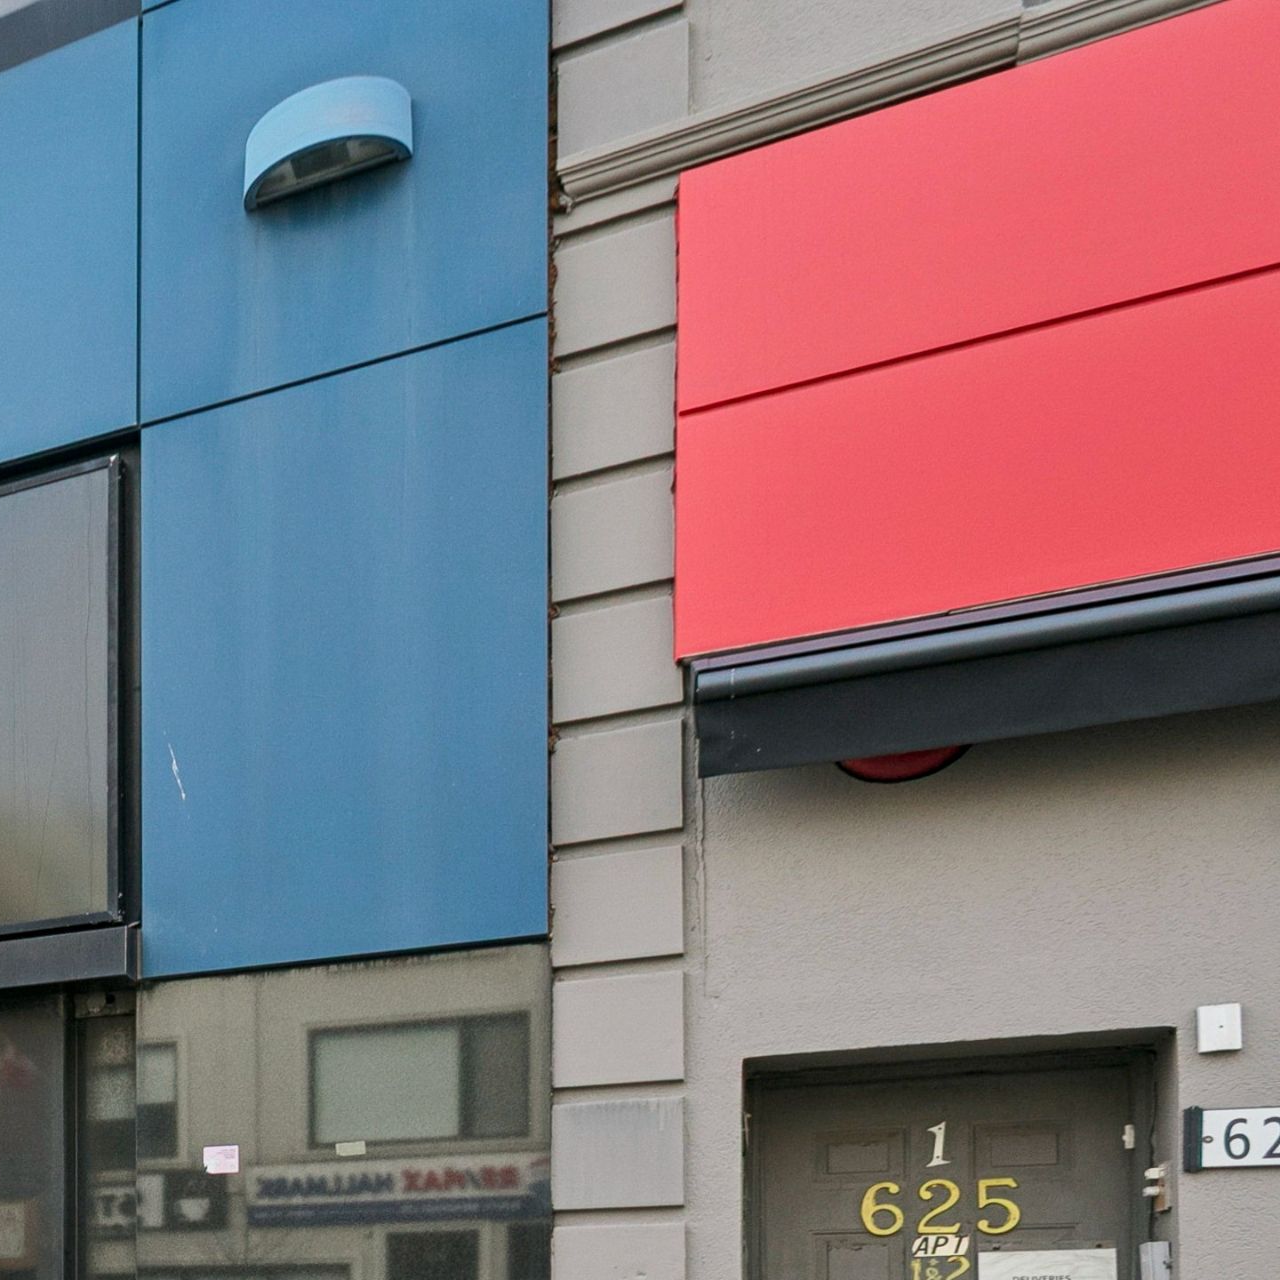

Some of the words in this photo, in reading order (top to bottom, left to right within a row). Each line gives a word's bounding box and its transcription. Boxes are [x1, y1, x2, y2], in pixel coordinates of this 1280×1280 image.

[926, 1121, 951, 1167] 1
[1223, 1116, 1280, 1160] 62
[861, 1178, 1021, 1236] 625
[914, 1236, 969, 1256] APT
